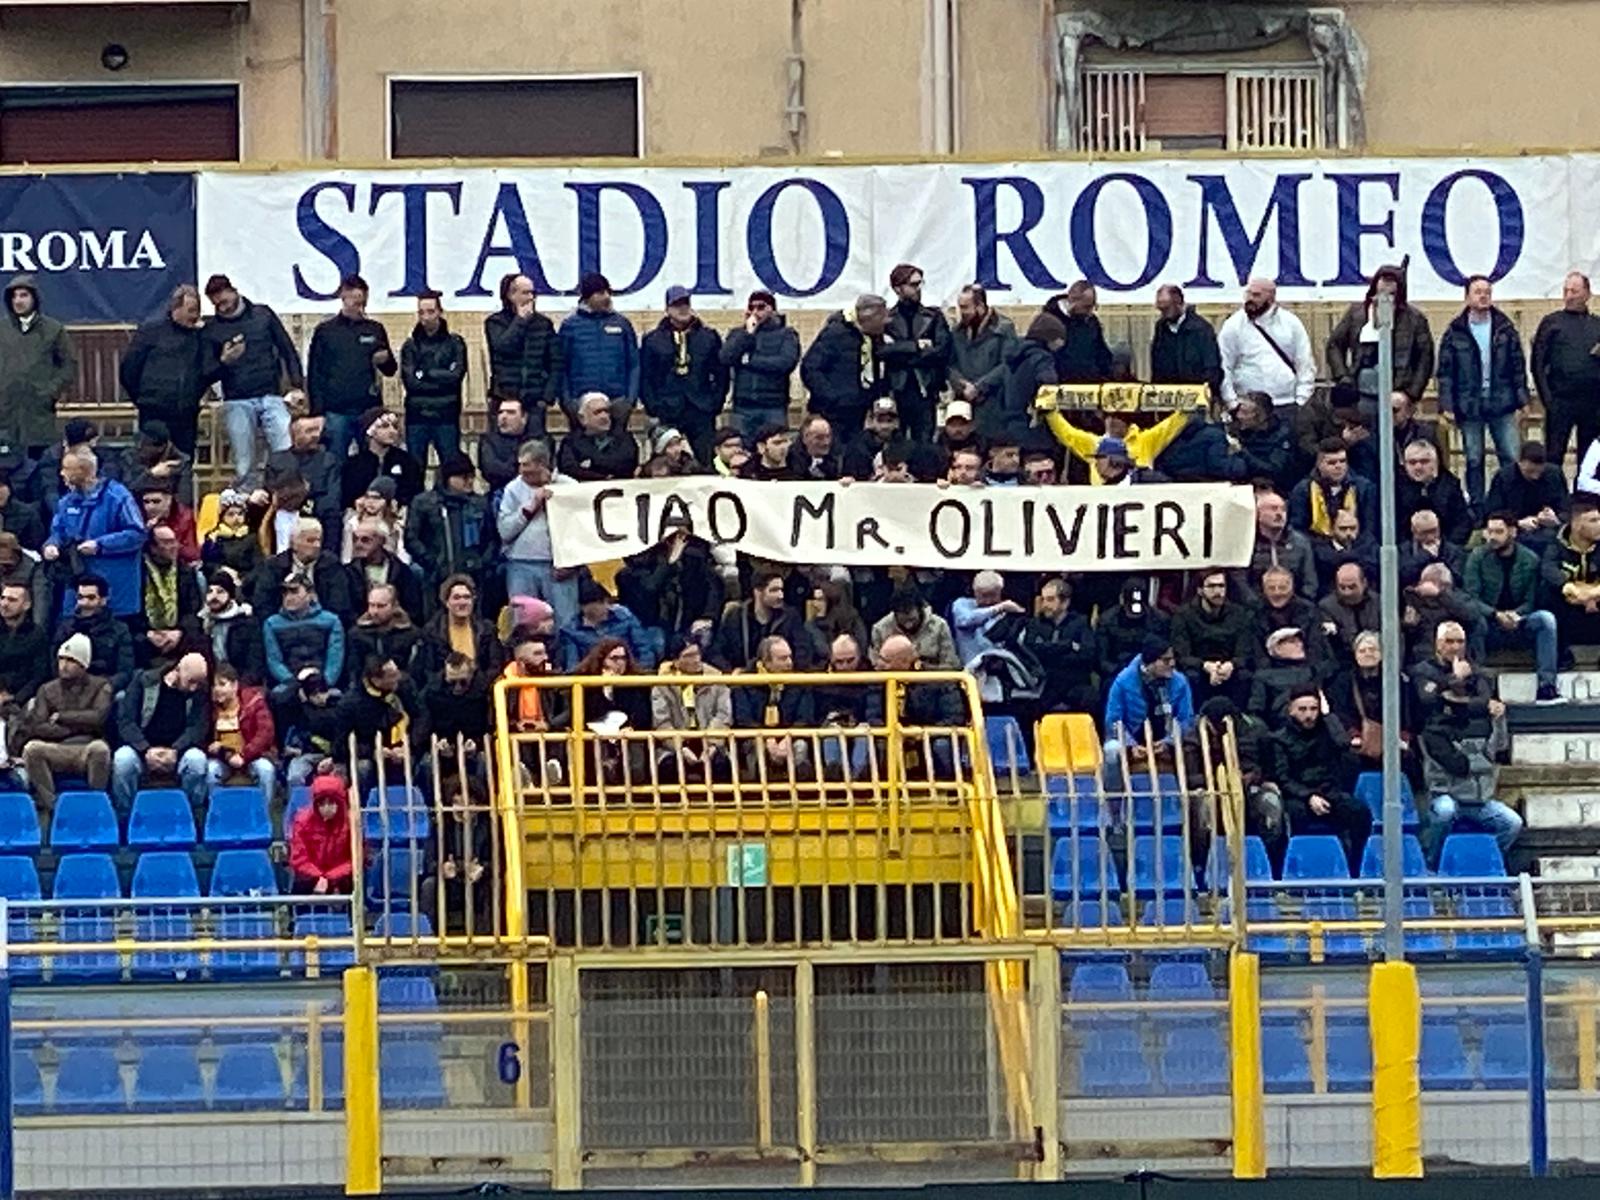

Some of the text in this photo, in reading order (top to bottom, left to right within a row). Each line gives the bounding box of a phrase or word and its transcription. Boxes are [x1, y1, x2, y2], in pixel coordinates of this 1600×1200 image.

[0, 230, 167, 271] ROMA
[292, 169, 1526, 300] STADIO ROMEO
[593, 488, 748, 545] CIAO
[930, 498, 1213, 560] OLIVIERI
[498, 1042, 521, 1084] 6
